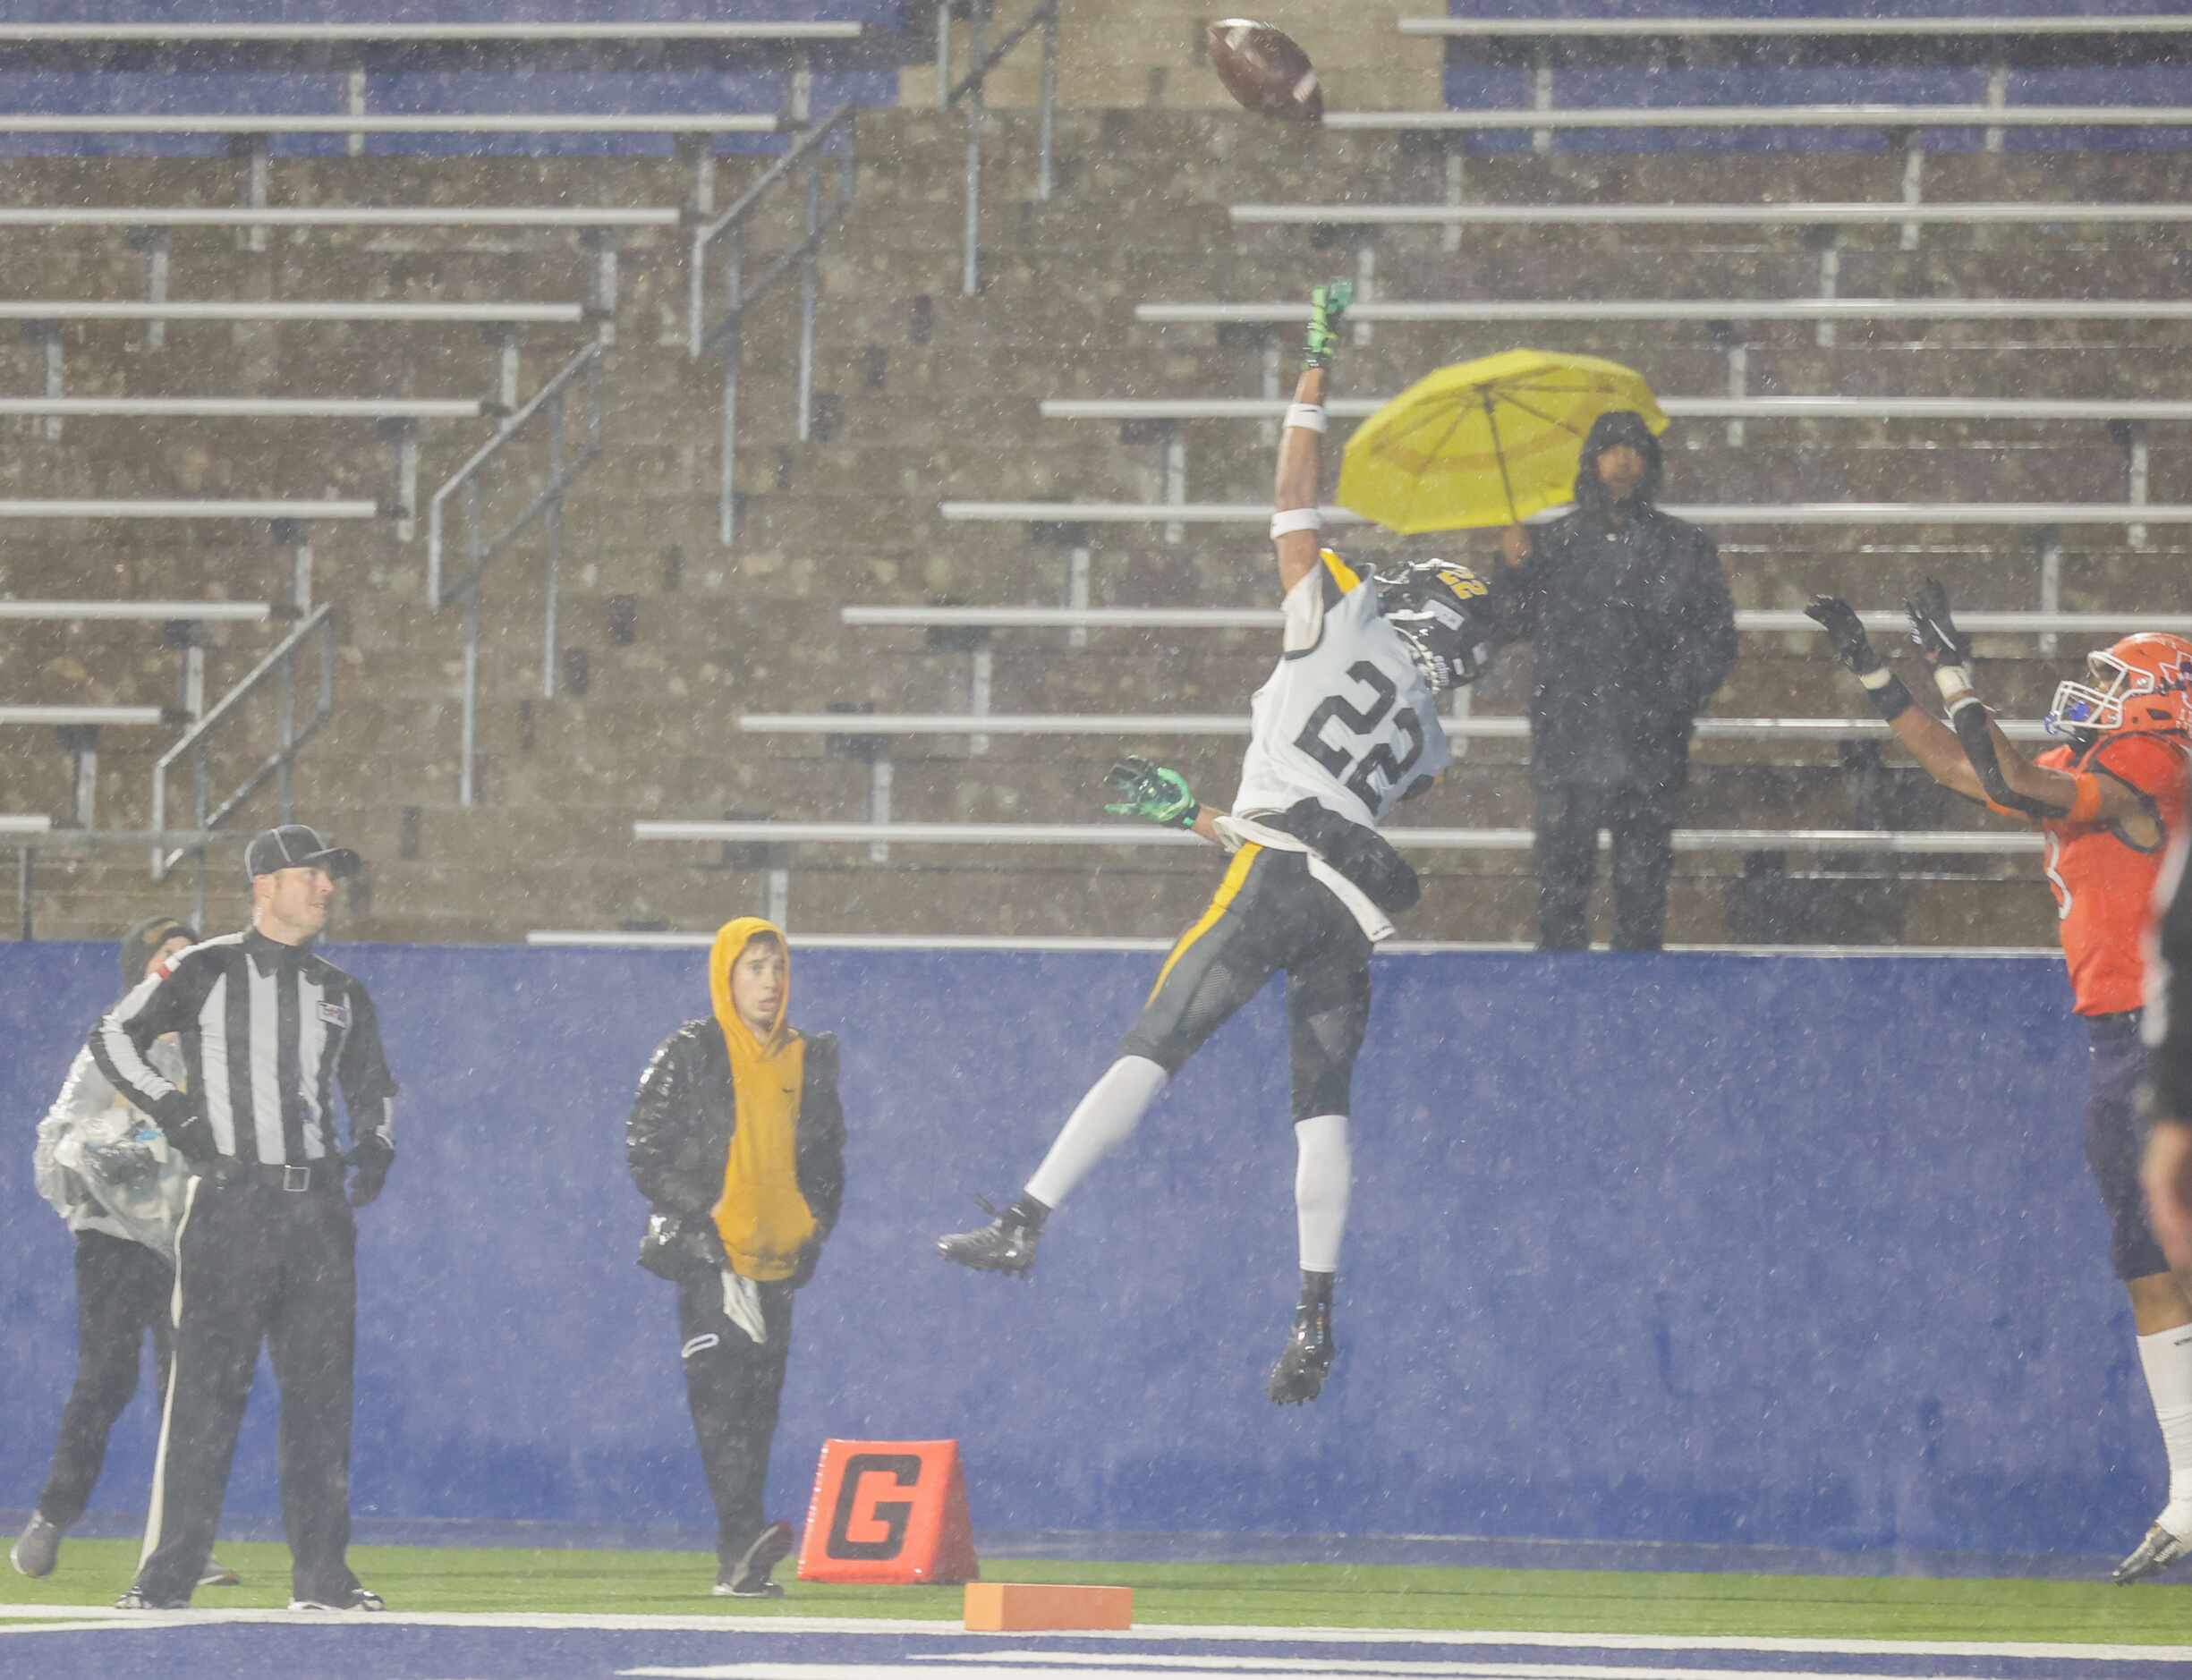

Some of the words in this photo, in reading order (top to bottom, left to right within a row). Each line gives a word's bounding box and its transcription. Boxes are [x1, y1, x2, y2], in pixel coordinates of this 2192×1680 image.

[1436, 569, 1489, 599] 22
[1293, 660, 1424, 817] 22
[825, 1453, 922, 1560] G
